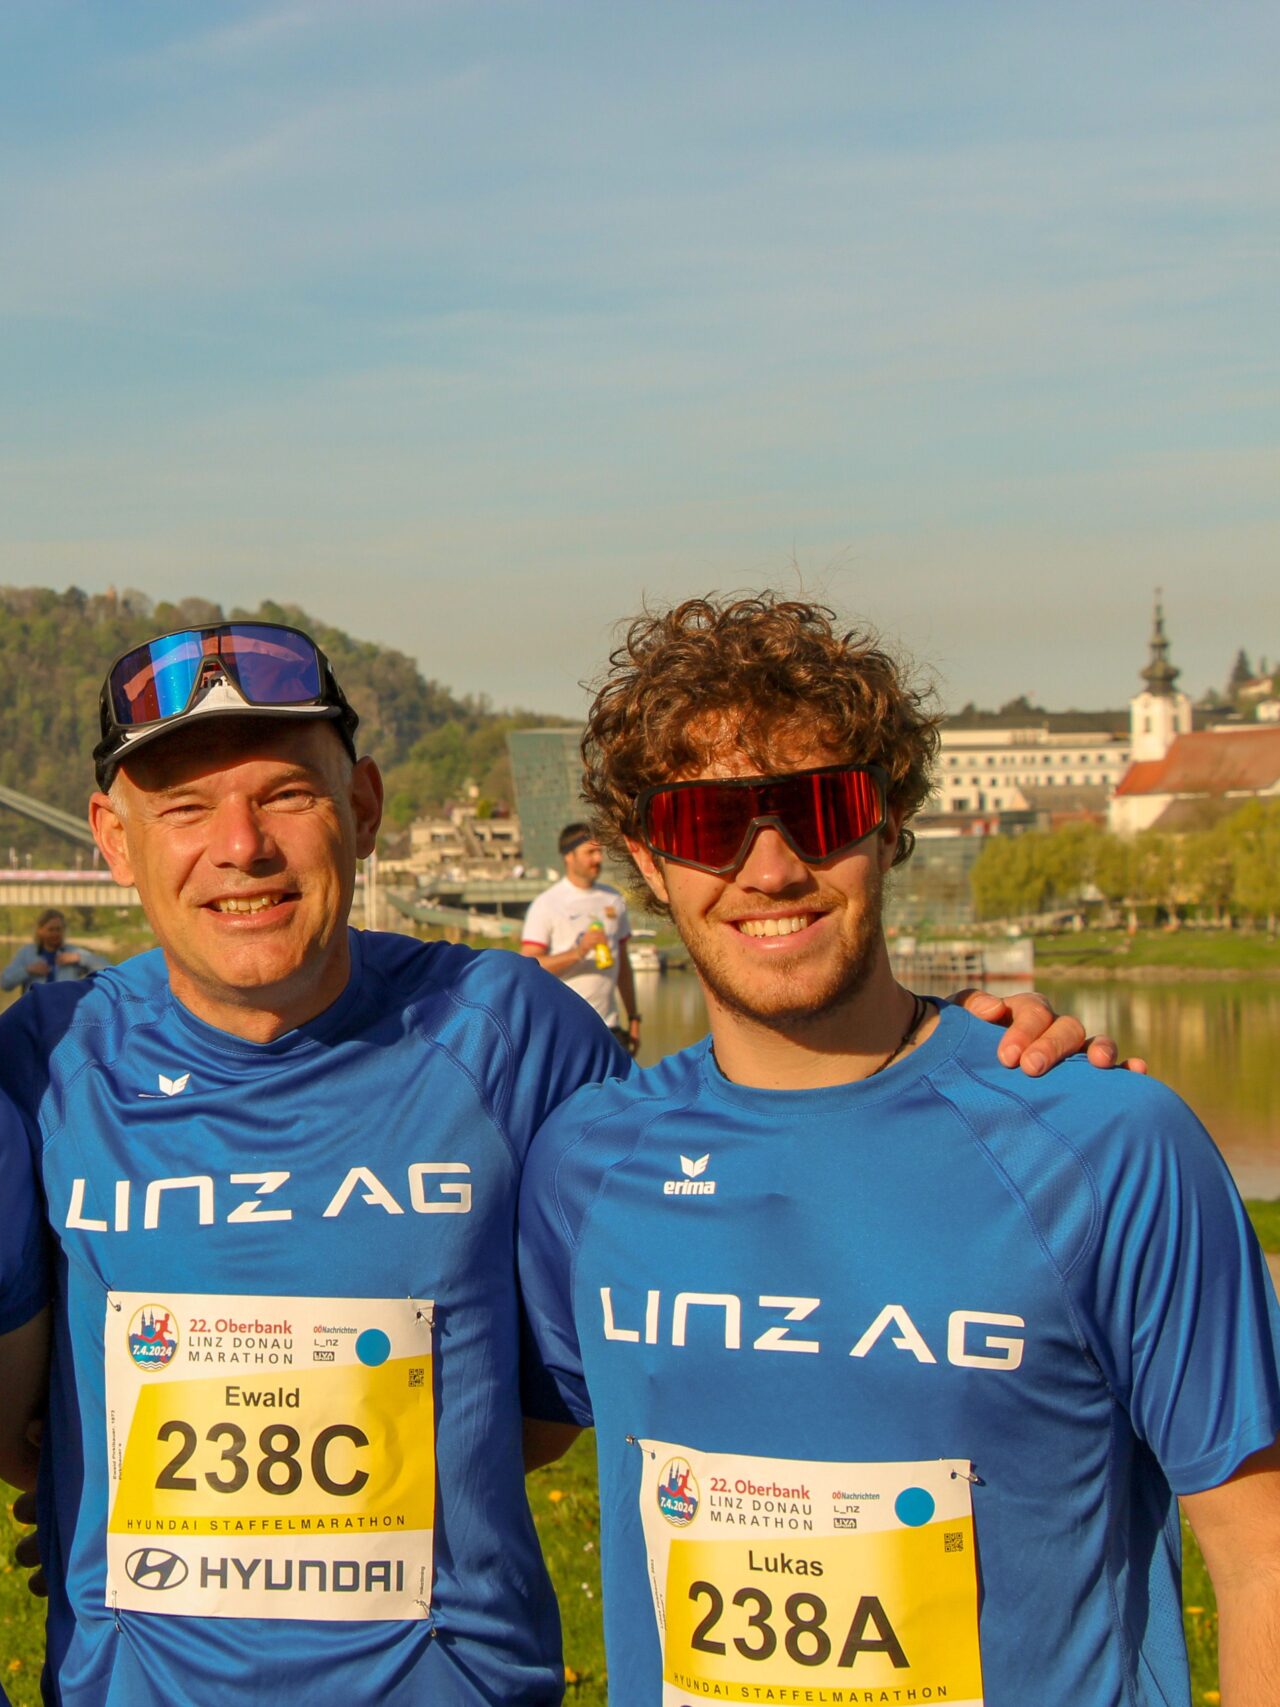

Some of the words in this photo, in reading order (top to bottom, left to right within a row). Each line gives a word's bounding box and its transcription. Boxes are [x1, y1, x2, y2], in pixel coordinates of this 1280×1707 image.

[65, 1171, 292, 1232] LINZ
[322, 1162, 472, 1218] AG
[663, 1178, 716, 1196] erima
[189, 1319, 212, 1334] 22.
[215, 1319, 293, 1335] Oberbank
[600, 1287, 821, 1354] LINZ
[849, 1304, 1025, 1371] AG
[132, 1344, 172, 1357] 7.4.2024
[188, 1336, 223, 1348] LINZ
[233, 1337, 293, 1350] DONAU
[188, 1352, 293, 1365] MARATHON
[225, 1385, 300, 1408] Ewald
[155, 1420, 370, 1497] 238C
[710, 1477, 732, 1493] 22.
[734, 1479, 810, 1500] Oberbank
[660, 1496, 694, 1515] 7.4.2024
[710, 1495, 743, 1510] LINZ
[752, 1500, 813, 1516] DONAU
[127, 1519, 198, 1531] HYUNDAI
[210, 1515, 405, 1531] STAFFELMARATHON
[710, 1511, 813, 1531] MARATHON
[200, 1556, 404, 1592] HYUNDAI
[748, 1550, 824, 1577] Lukas
[688, 1581, 910, 1669] 238A
[673, 1672, 730, 1695] HYUNDAI
[741, 1685, 948, 1703] STAFFELMARATHON
